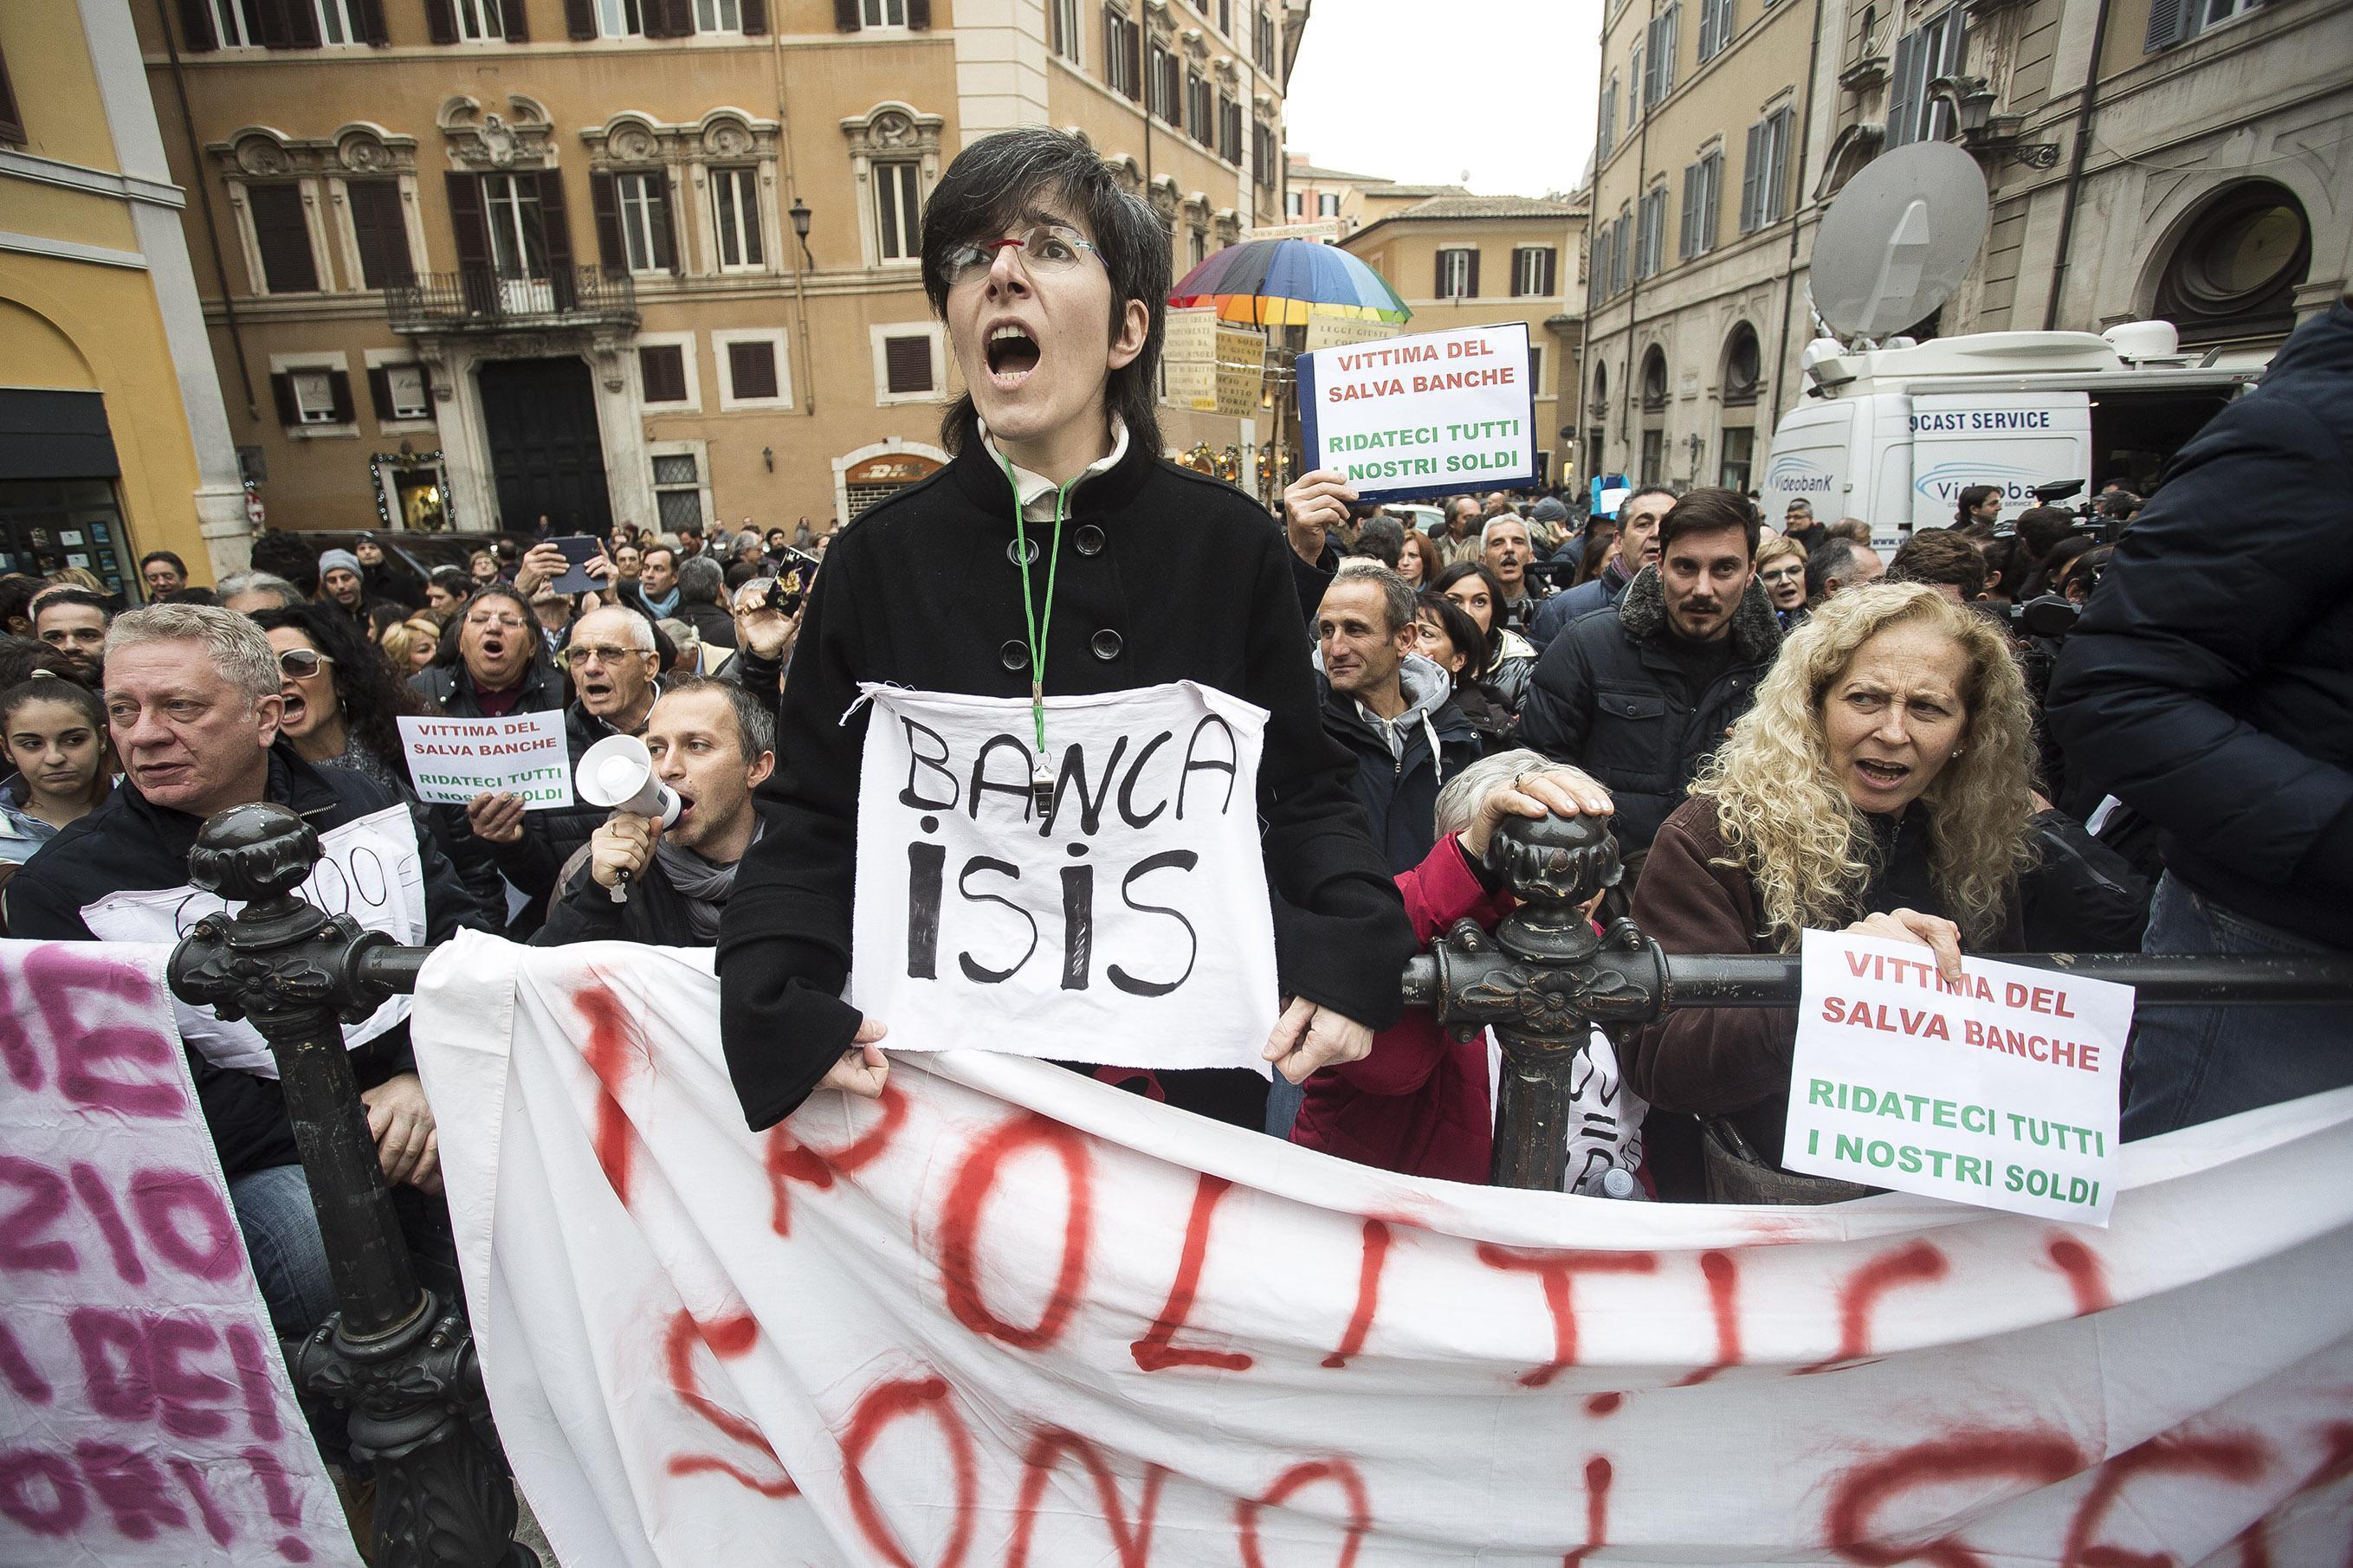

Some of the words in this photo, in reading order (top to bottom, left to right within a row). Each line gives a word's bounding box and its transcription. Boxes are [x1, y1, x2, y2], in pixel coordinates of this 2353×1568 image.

[1338, 345, 1438, 371] VITTIMA
[1447, 339, 1494, 358] DEL
[1328, 378, 1405, 403] SALVA
[1413, 367, 1515, 392] BANCHE
[1329, 427, 1438, 453] RIDATECI
[1446, 420, 1519, 441] TUTTI
[1972, 412, 2050, 429] SERVICE
[1348, 457, 1438, 481] NOSTRI
[1446, 450, 1517, 473] SOLDI
[417, 724, 498, 737] VITTIMA
[504, 721, 540, 735] DEL
[413, 743, 474, 756] SALVA
[479, 737, 557, 756] BANCHE
[419, 773, 502, 788] RIDATECI
[507, 767, 562, 784] TUTTI
[899, 713, 1238, 837] BANCA
[425, 790, 433, 799] I
[437, 791, 476, 802] NOS
[1845, 951, 1995, 1003] VITTIMA
[2006, 982, 2075, 1019] DEL
[1822, 997, 1950, 1041] SALVA
[1964, 1019, 2100, 1073] BANCHE
[1809, 1078, 1996, 1136] RIDATECI
[2007, 1113, 2104, 1158] TUTTI
[1808, 1129, 1820, 1156] I
[1835, 1133, 1992, 1187] NOSTRI
[2005, 1165, 2099, 1207] SOLDI
